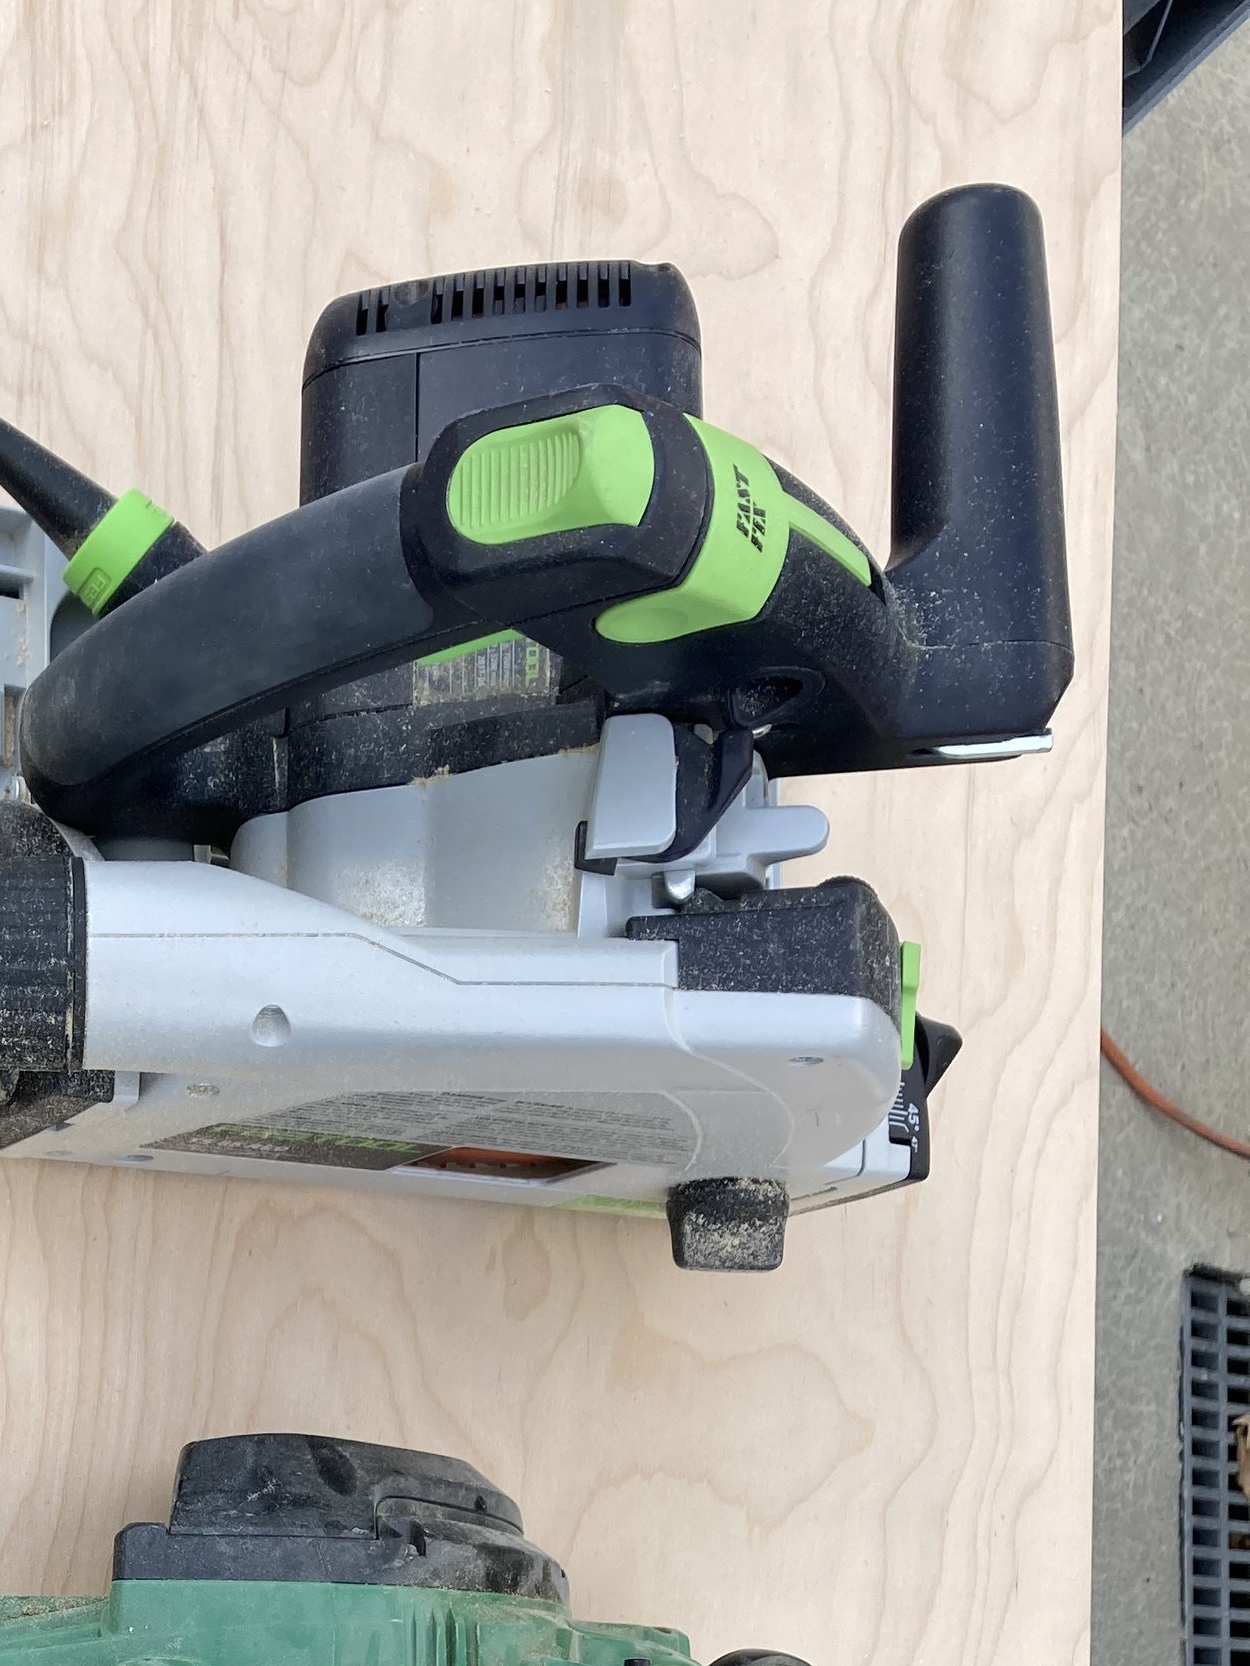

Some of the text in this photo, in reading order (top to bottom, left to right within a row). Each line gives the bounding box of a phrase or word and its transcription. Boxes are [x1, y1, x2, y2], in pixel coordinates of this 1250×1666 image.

[732, 463, 751, 539] FAST
[751, 500, 767, 554] FIX
[908, 1102, 920, 1132] 45°
